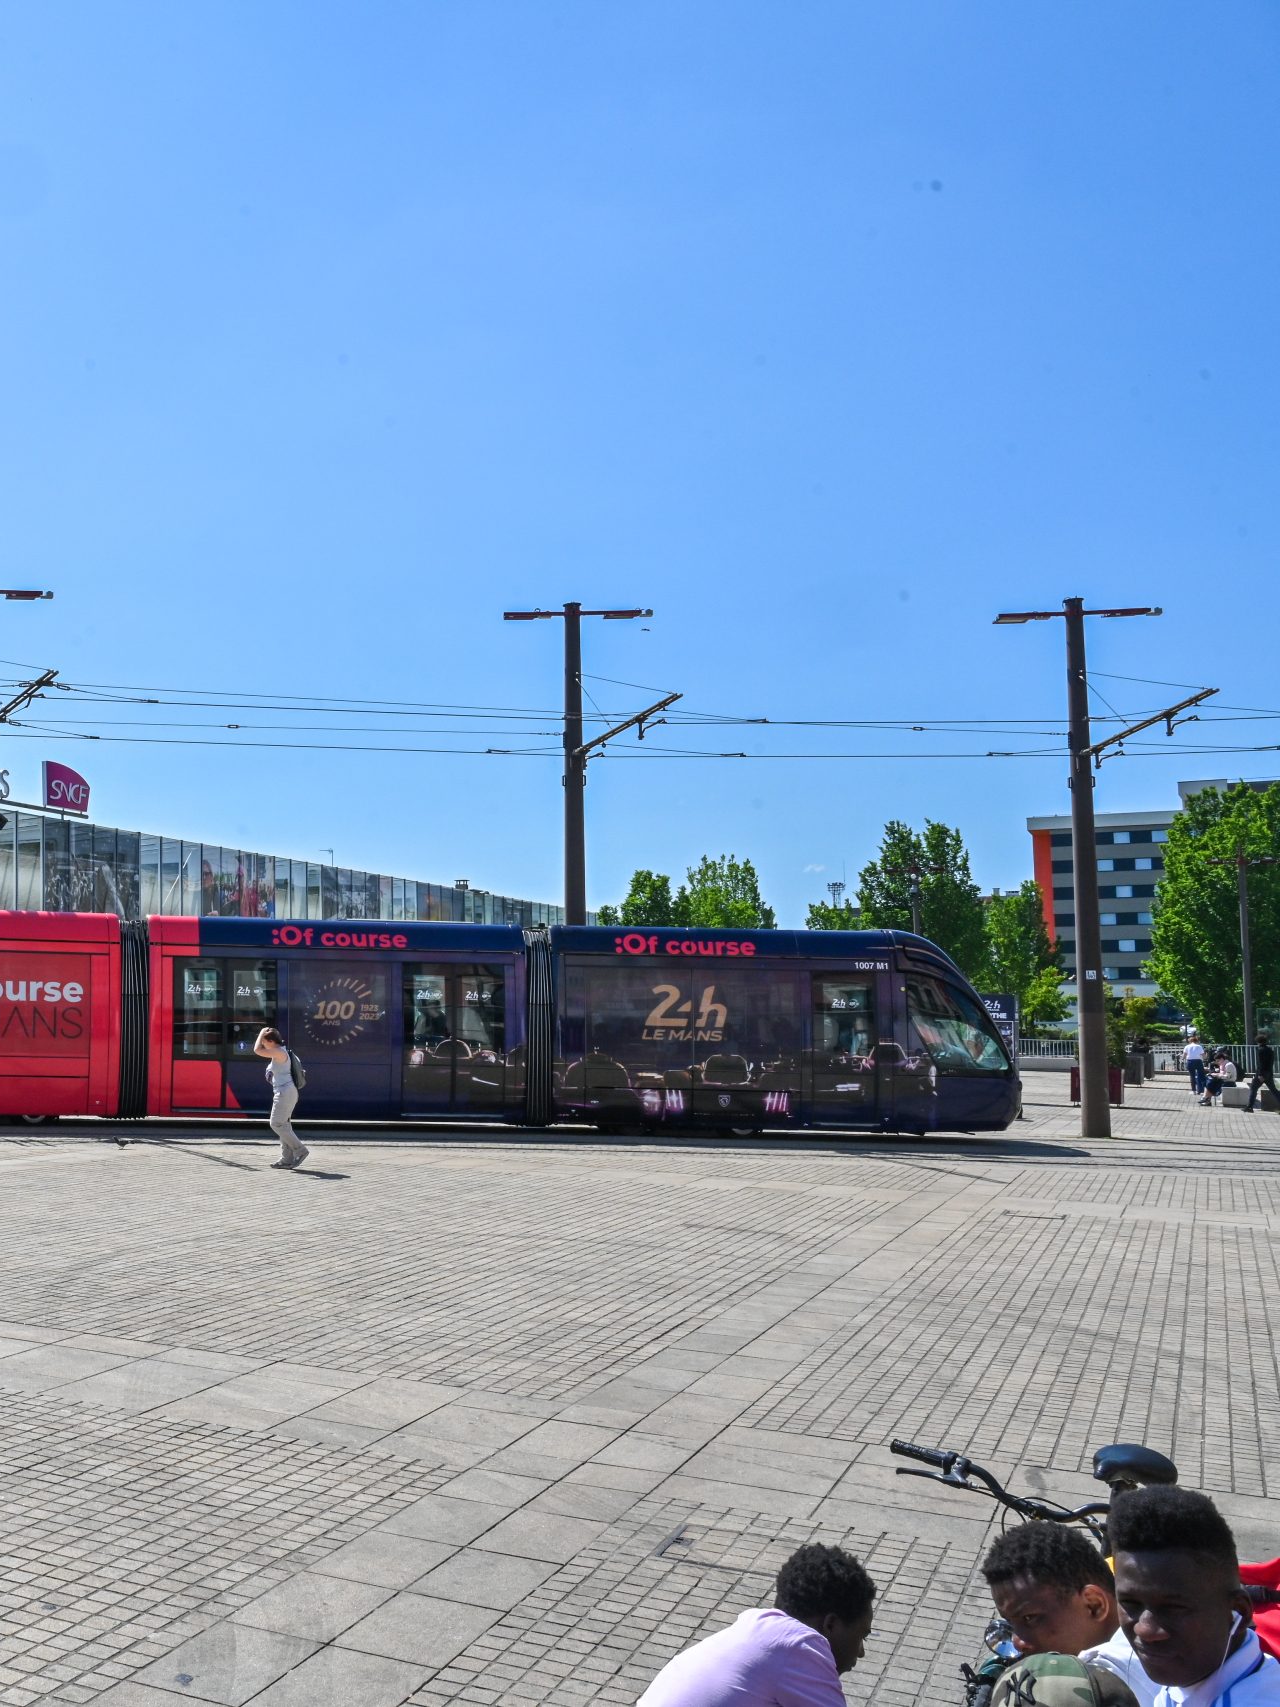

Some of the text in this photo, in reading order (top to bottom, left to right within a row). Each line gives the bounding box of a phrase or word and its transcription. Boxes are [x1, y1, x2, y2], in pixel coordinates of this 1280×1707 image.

[49, 779, 89, 804] SNCF
[320, 932, 408, 948] course
[665, 940, 757, 956] course
[854, 961, 889, 970] 1007 M1
[313, 1000, 355, 1020] 100
[322, 1019, 341, 1027] ANS
[641, 1029, 724, 1042] LE MANS
